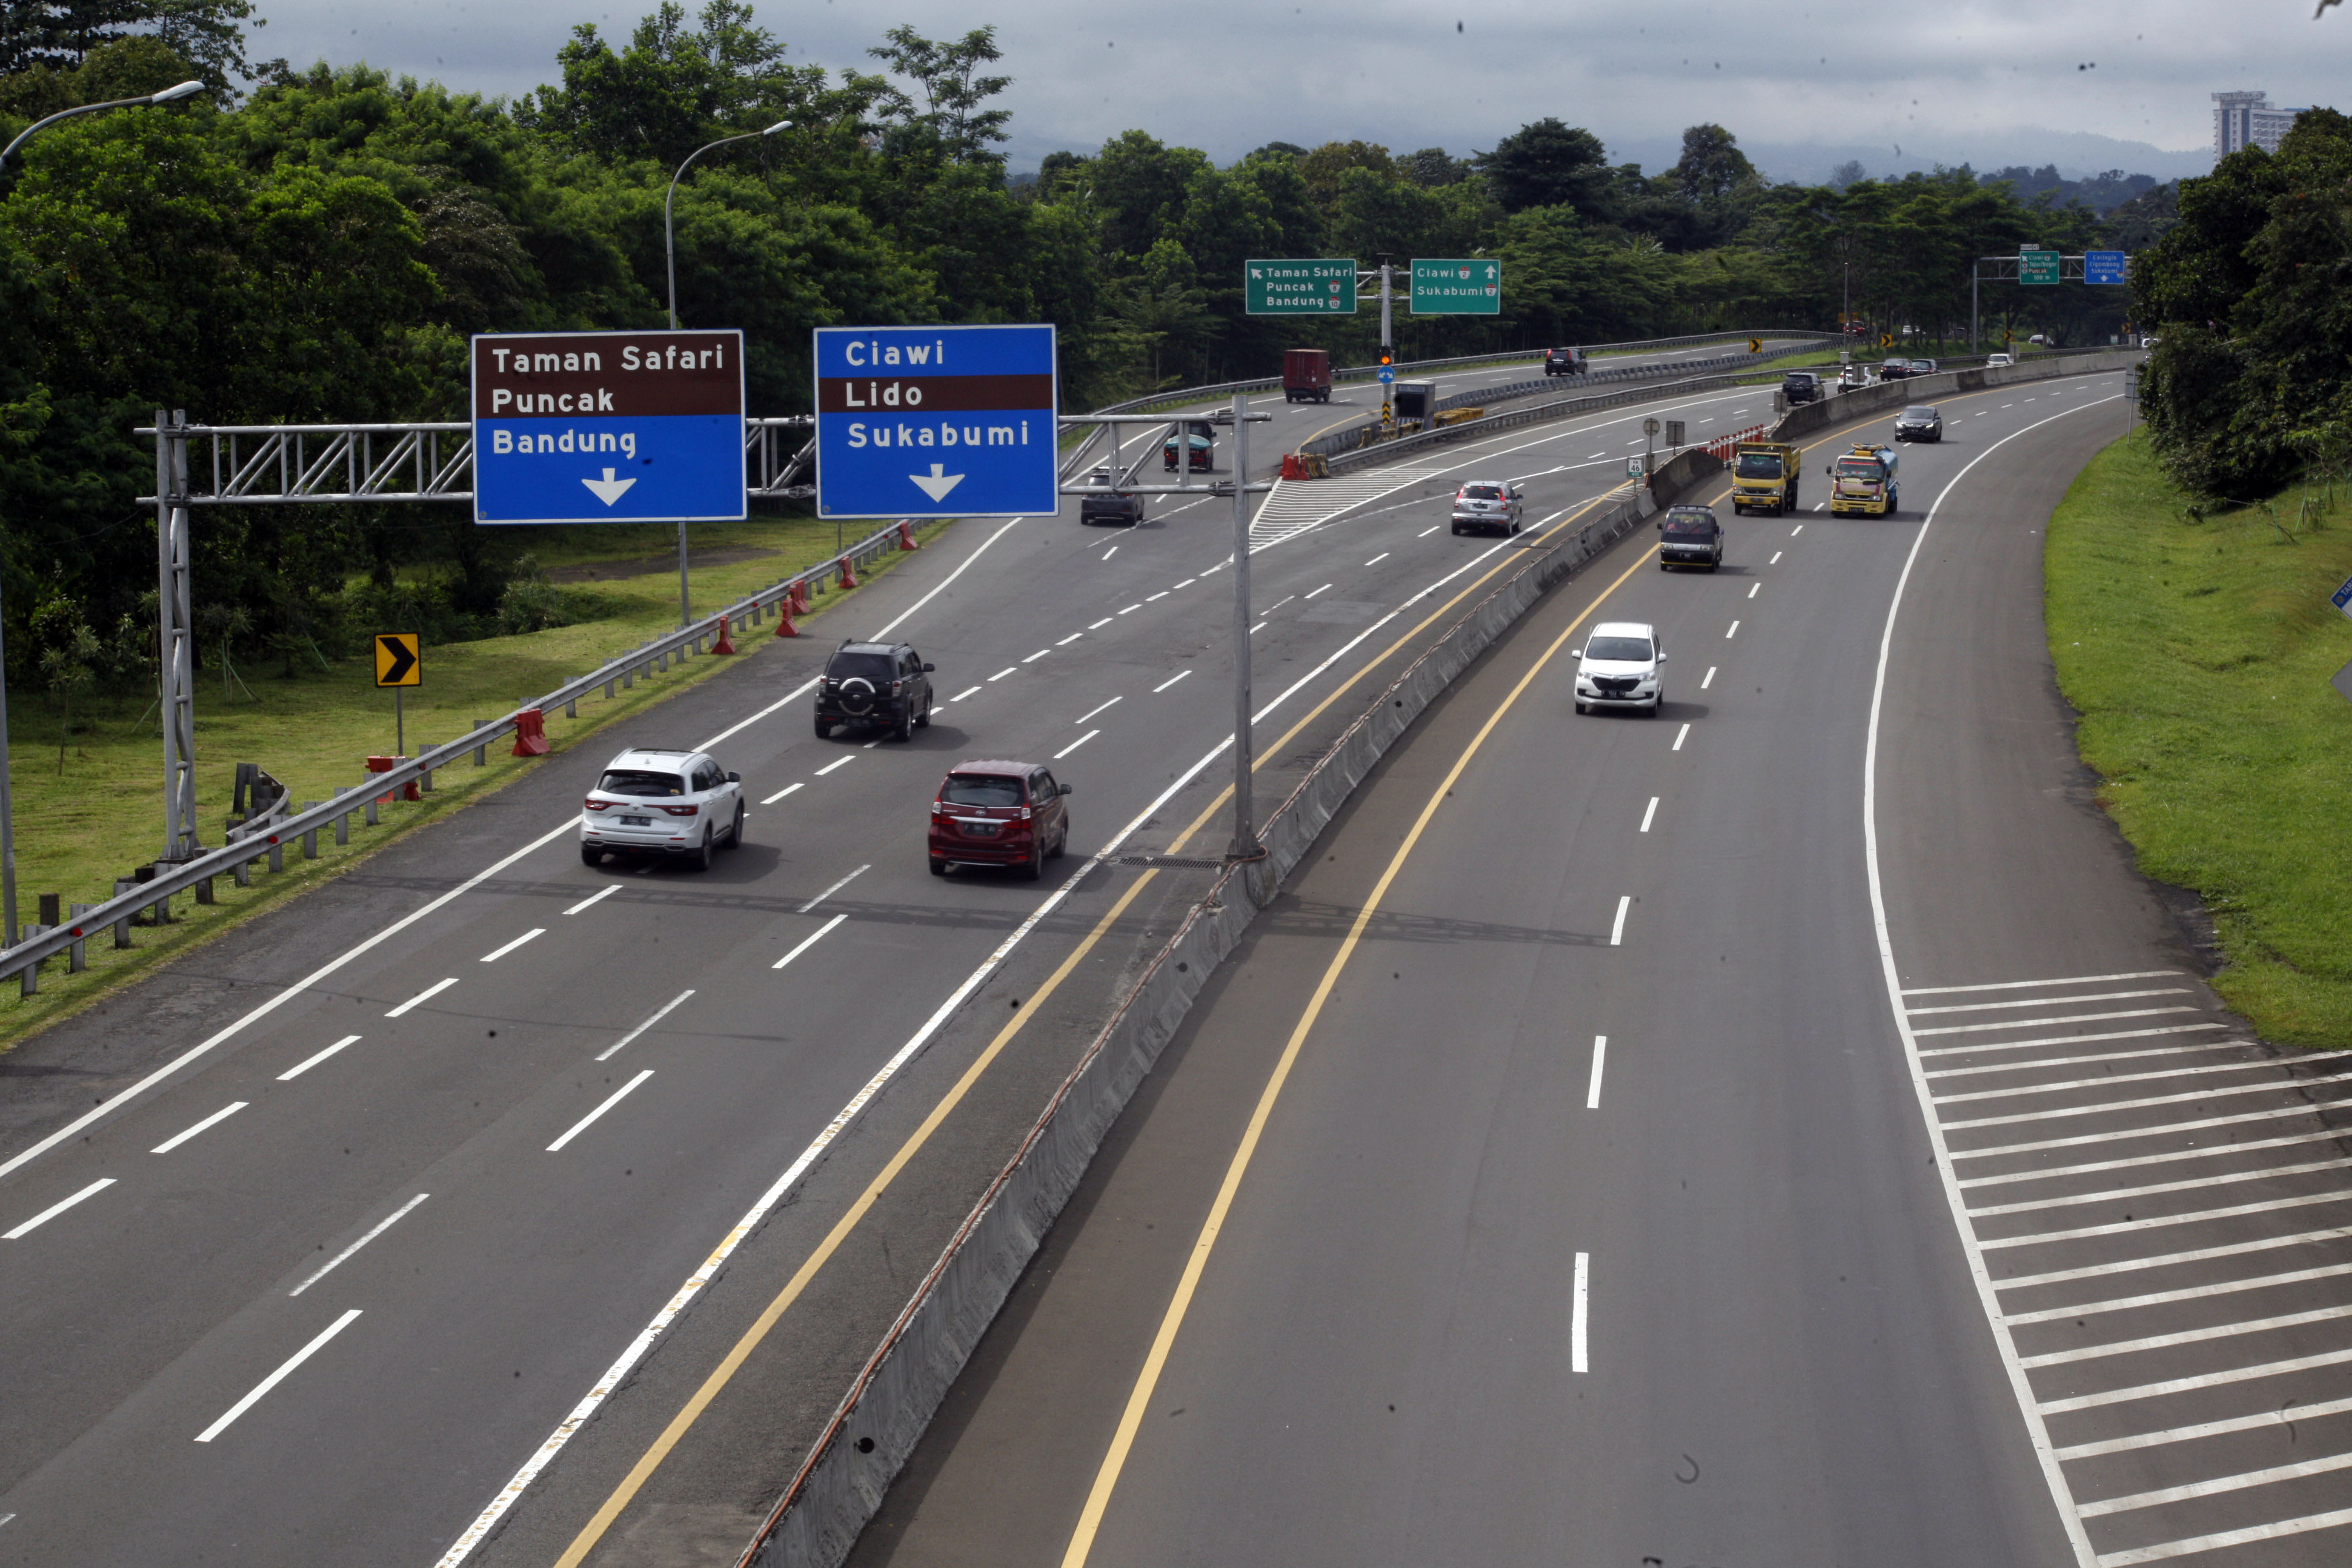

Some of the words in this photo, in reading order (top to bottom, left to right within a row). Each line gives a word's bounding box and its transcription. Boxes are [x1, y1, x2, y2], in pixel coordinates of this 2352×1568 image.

[1267, 268, 1309, 277] Taman
[1314, 267, 1352, 276] Safari
[1418, 268, 1454, 277] Ciawi
[1267, 282, 1314, 291] Puncak
[1418, 286, 1483, 296] Sukabumi
[1267, 297, 1324, 308] Bandung
[493, 348, 601, 373] Taman
[621, 344, 723, 371] Safari
[846, 339, 943, 366] Ciawi
[493, 387, 614, 413] Puncak
[847, 382, 922, 407] Lido
[493, 429, 636, 459] Bandung
[848, 420, 1028, 448] Sukabumi
